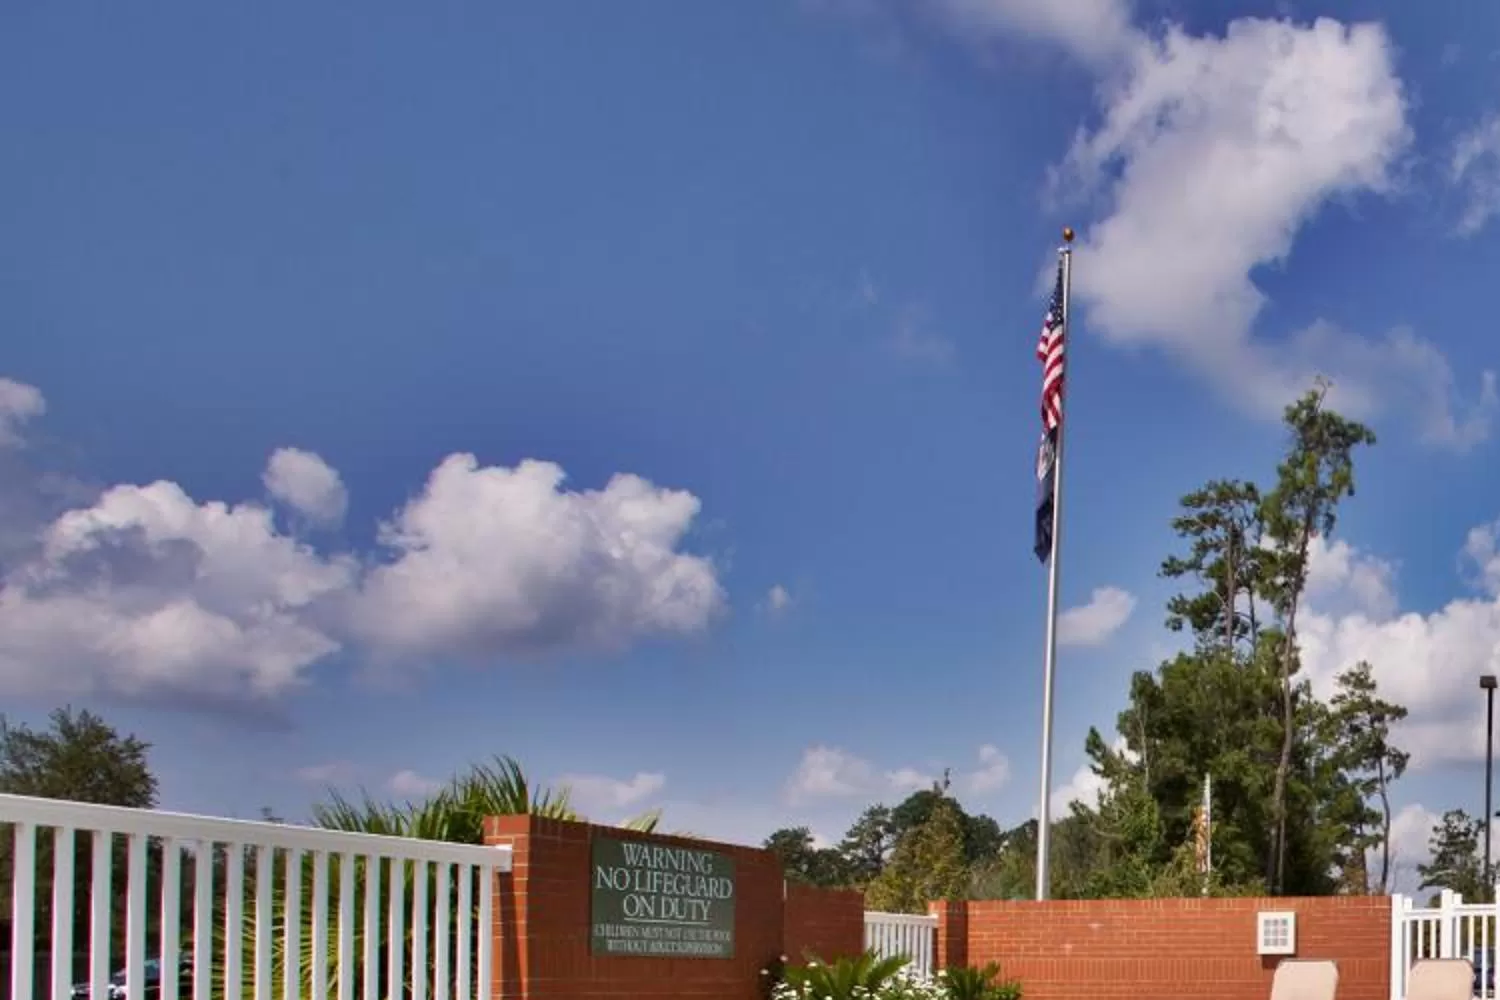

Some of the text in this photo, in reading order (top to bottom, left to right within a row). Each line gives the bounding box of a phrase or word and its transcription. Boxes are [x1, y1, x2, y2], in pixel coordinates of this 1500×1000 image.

[622, 843, 713, 875] WARNING
[596, 865, 733, 899] NO LIFEGUARD
[623, 893, 712, 921] ON DUTY
